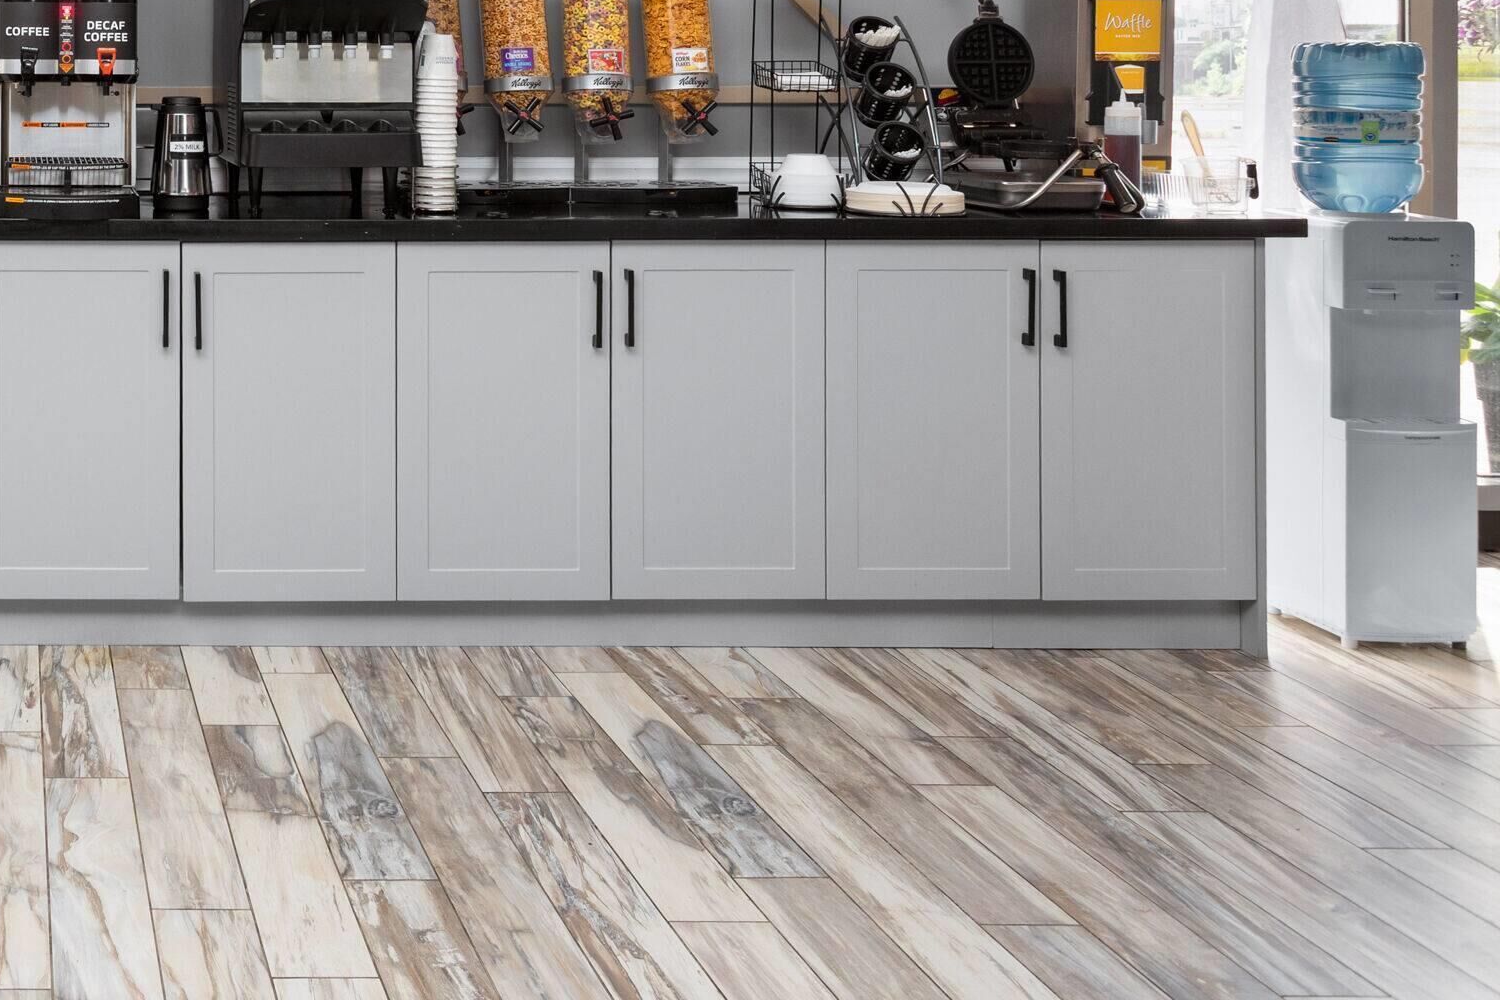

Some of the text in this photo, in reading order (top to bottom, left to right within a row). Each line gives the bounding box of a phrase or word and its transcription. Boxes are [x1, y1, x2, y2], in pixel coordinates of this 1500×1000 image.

[86, 20, 126, 31] DECAF
[1104, 12, 1152, 33] Waffle
[5, 26, 50, 37] COFFEE
[84, 32, 128, 42] COFFEE
